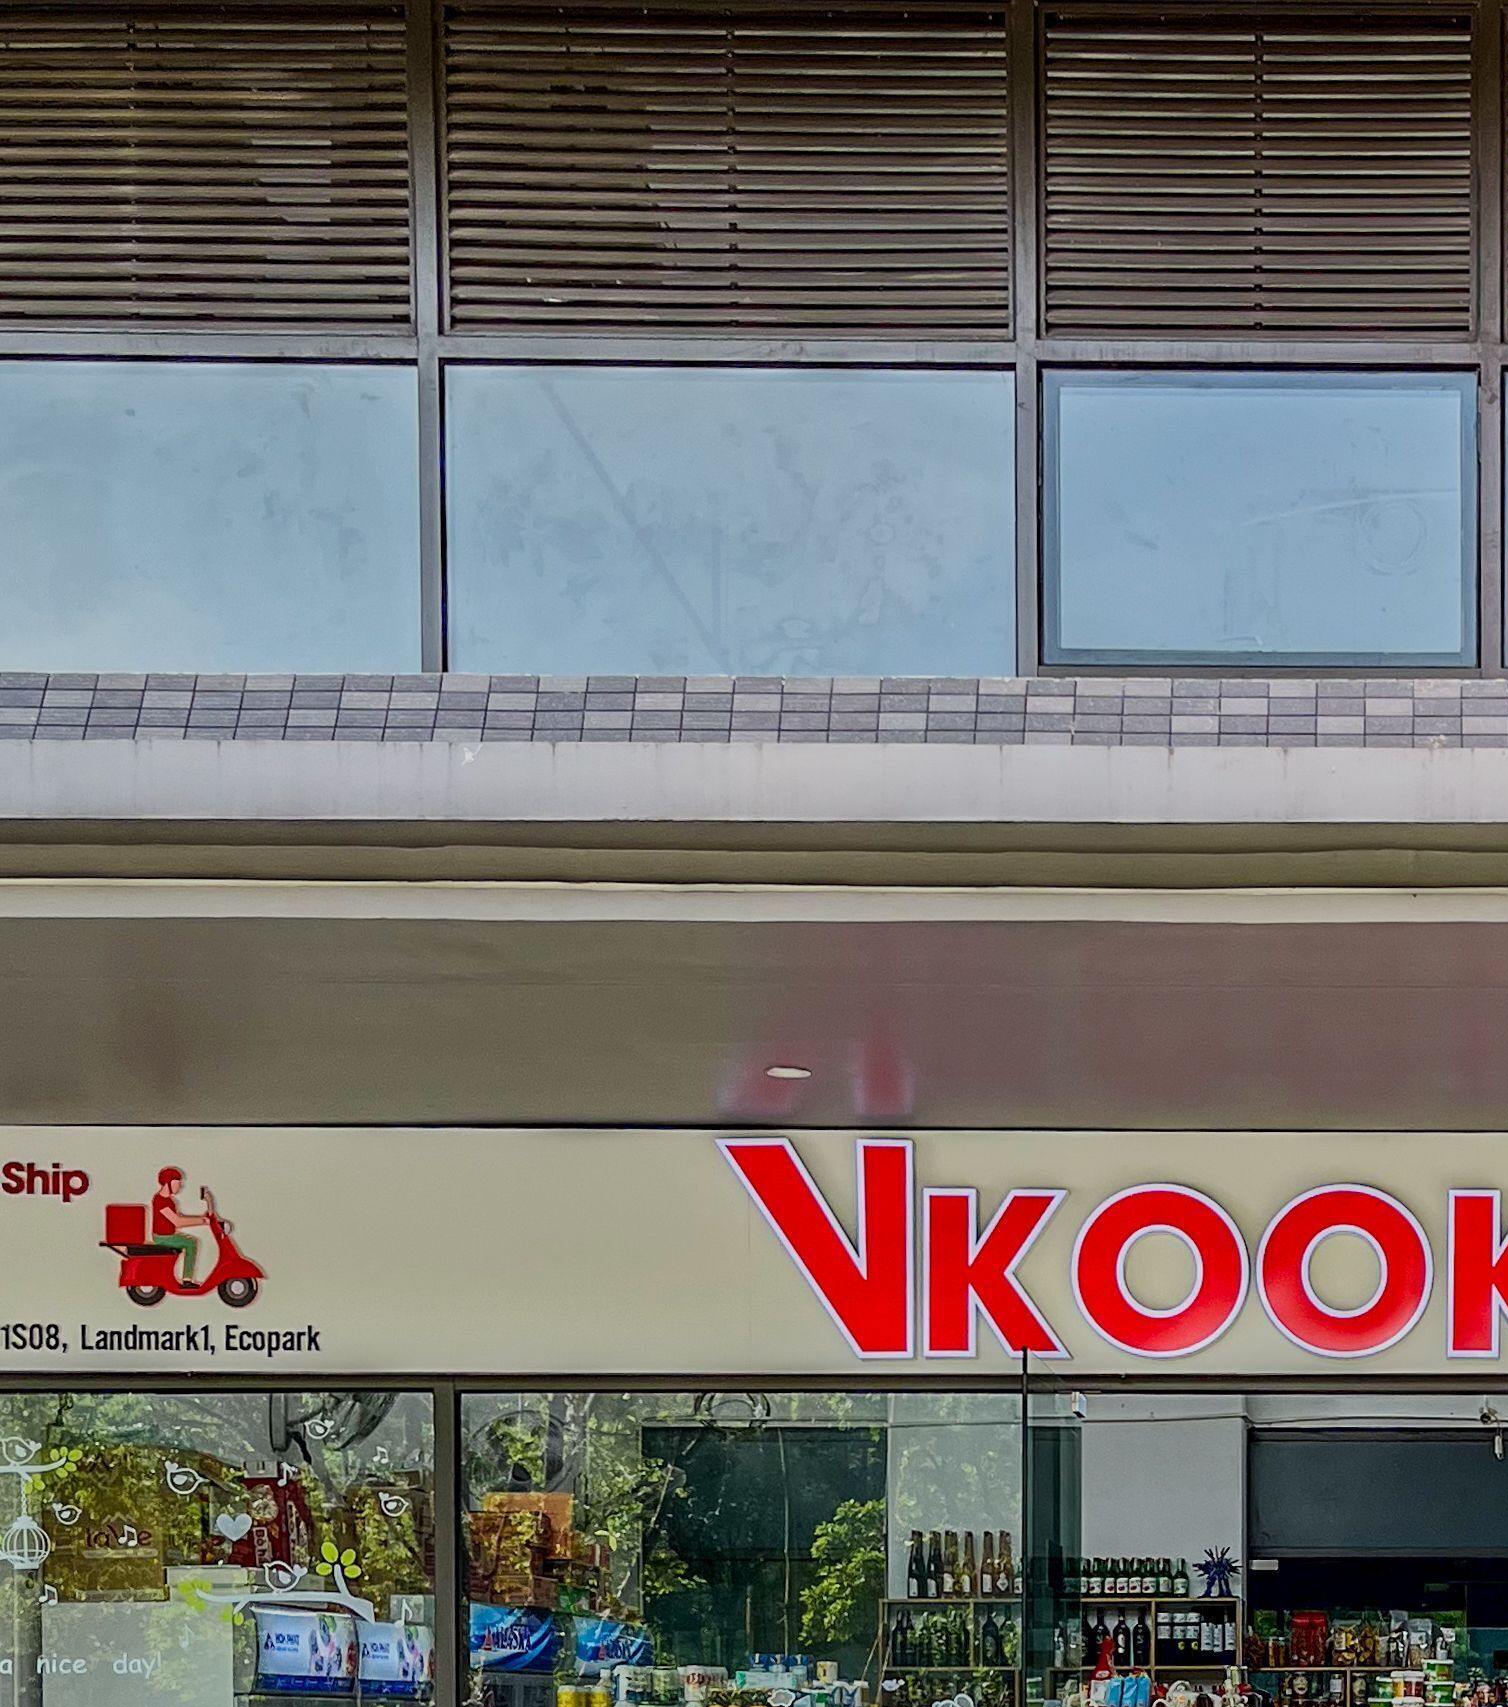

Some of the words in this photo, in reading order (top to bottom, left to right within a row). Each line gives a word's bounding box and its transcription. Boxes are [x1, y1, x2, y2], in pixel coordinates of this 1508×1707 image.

[1, 1162, 89, 1203] Ship
[81, 1324, 215, 1355] Landmark1,
[225, 1325, 320, 1357] Ecopark
[36, 1653, 88, 1674] nice
[112, 1652, 161, 1679] day!
